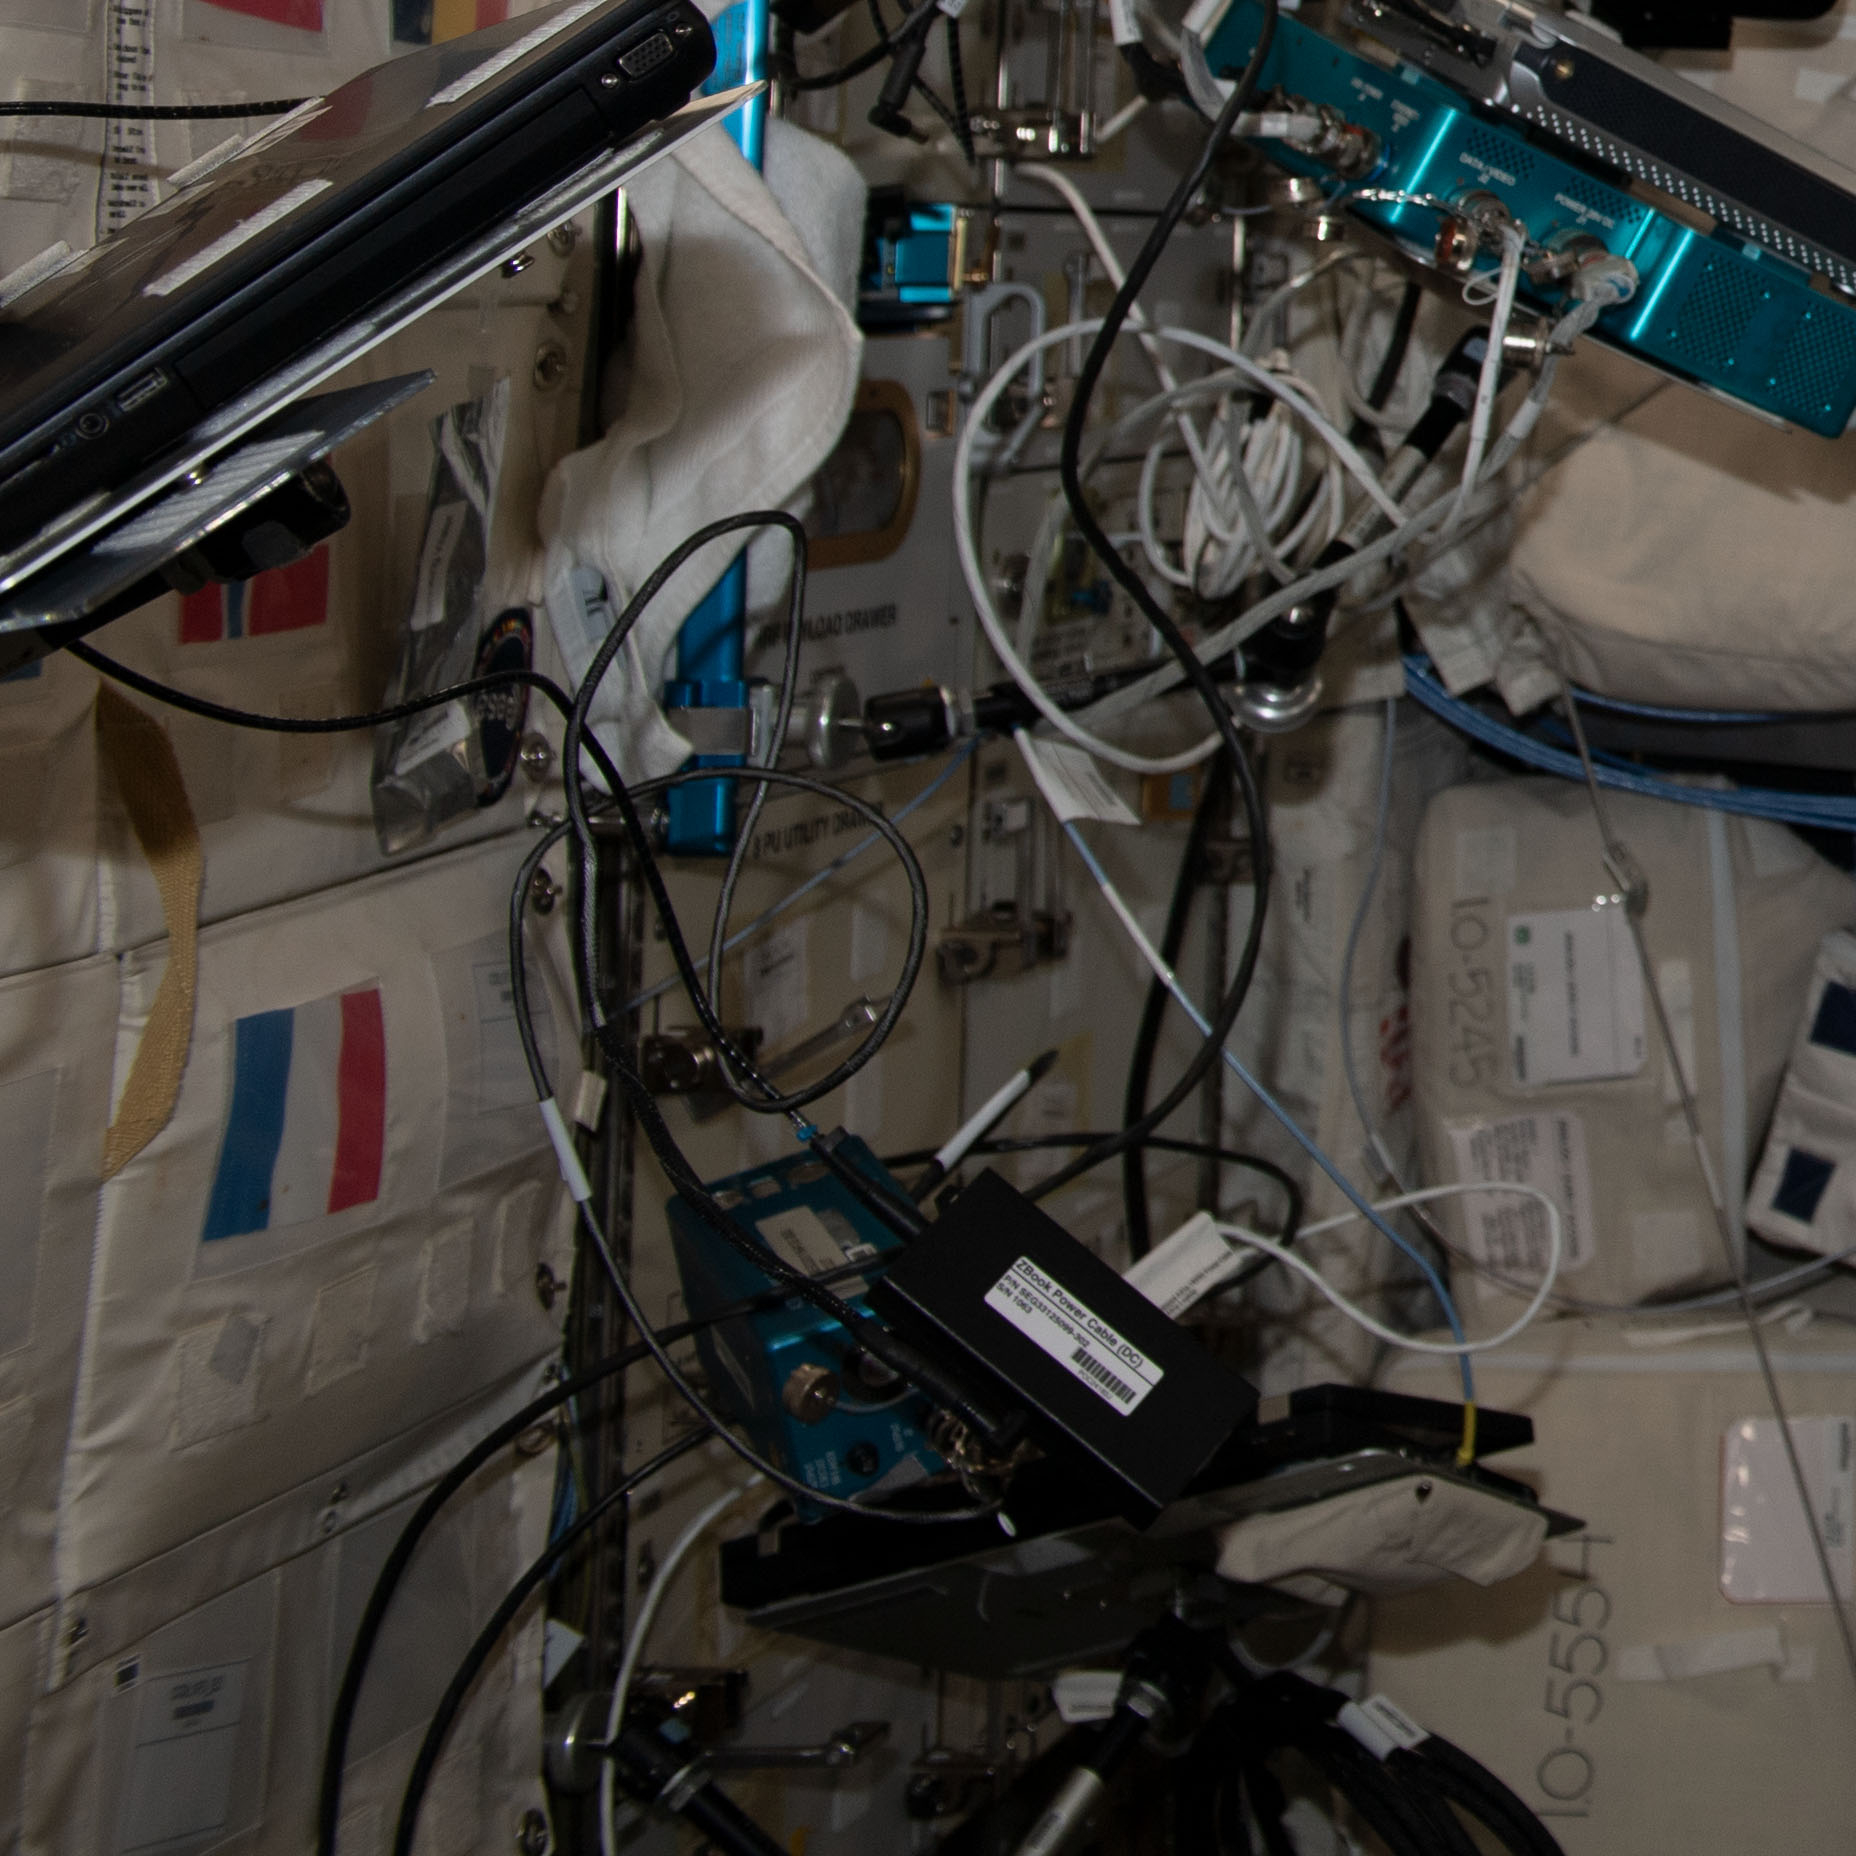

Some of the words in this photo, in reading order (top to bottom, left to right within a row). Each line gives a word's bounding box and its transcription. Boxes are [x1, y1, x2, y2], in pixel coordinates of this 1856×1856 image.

[995, 1280, 1014, 1298] S/N
[1011, 1294, 1033, 1315] 1063
[1002, 1273, 1020, 1291] P/N
[1015, 1258, 1053, 1293] ZBook
[1050, 1286, 1088, 1322] Power
[1085, 1315, 1120, 1347] Cable
[1114, 1341, 1144, 1371] (DC)
